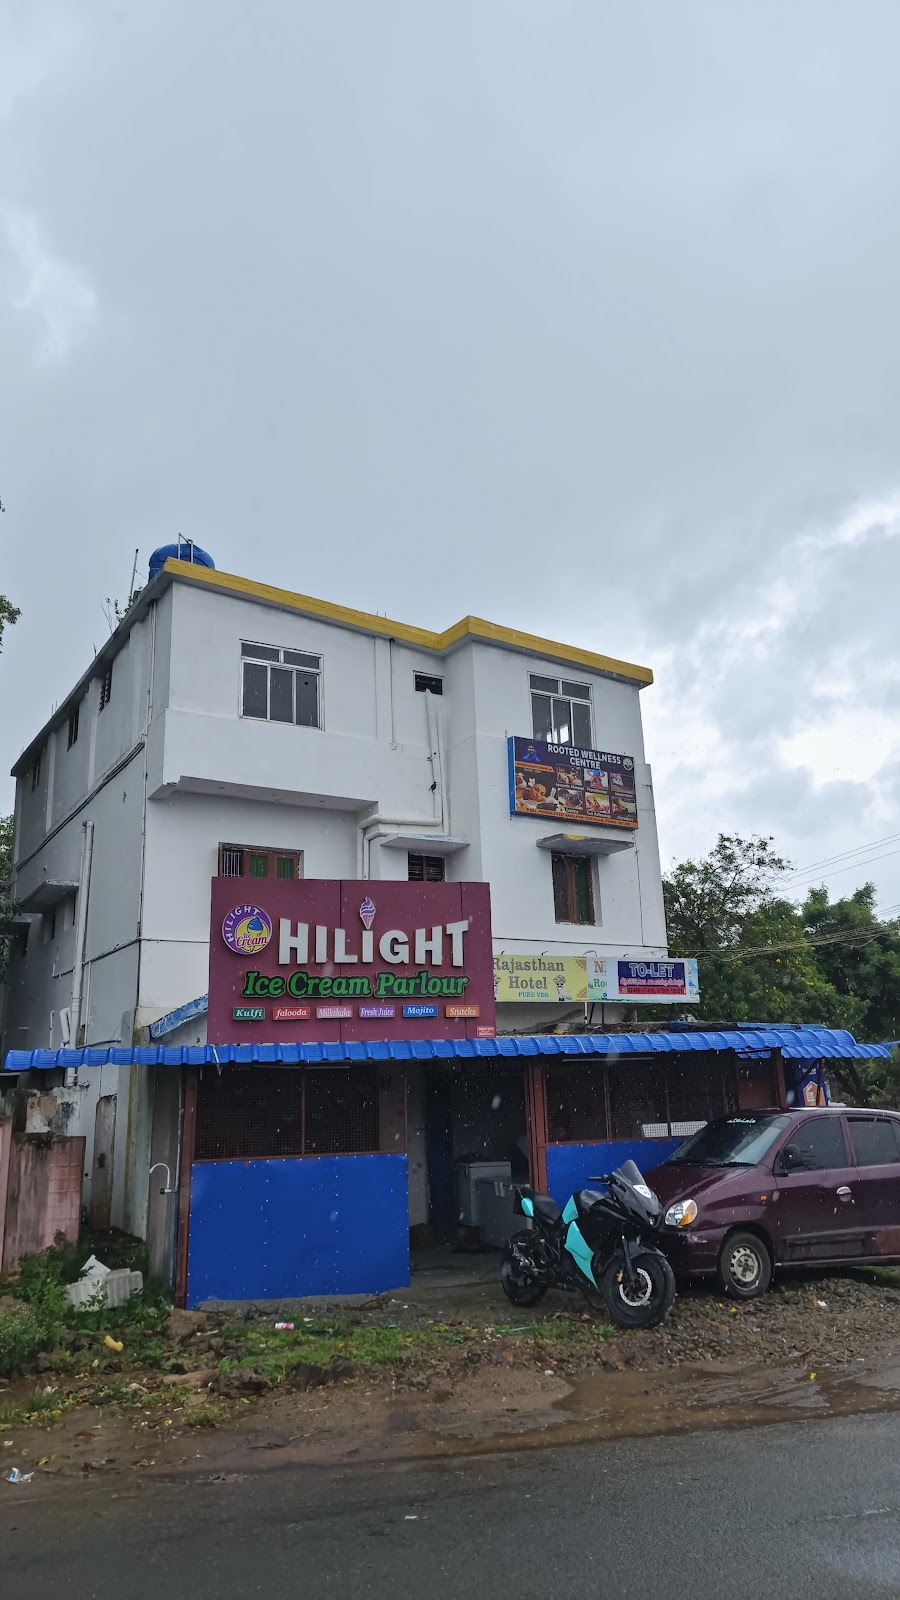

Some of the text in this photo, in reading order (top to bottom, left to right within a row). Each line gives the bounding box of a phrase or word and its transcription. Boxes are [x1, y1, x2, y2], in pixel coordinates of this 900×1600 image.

[547, 744, 621, 765] ROOTED WELLNESS
[570, 757, 601, 770] CENTRE
[225, 905, 261, 943] HILIGHT
[236, 936, 268, 947] Cream
[493, 957, 565, 974] Rajasthan
[628, 962, 675, 978] TO-LET
[243, 971, 469, 997] Ice Cream Parlour
[508, 976, 548, 990] Hotel
[235, 1008, 263, 1018] Kulfi
[275, 1008, 308, 1018] falooda
[318, 1008, 352, 1018] Milkshake
[360, 1007, 394, 1017] Fresh Juice
[407, 1006, 434, 1016] Mojito
[449, 1007, 477, 1016] Snacks
